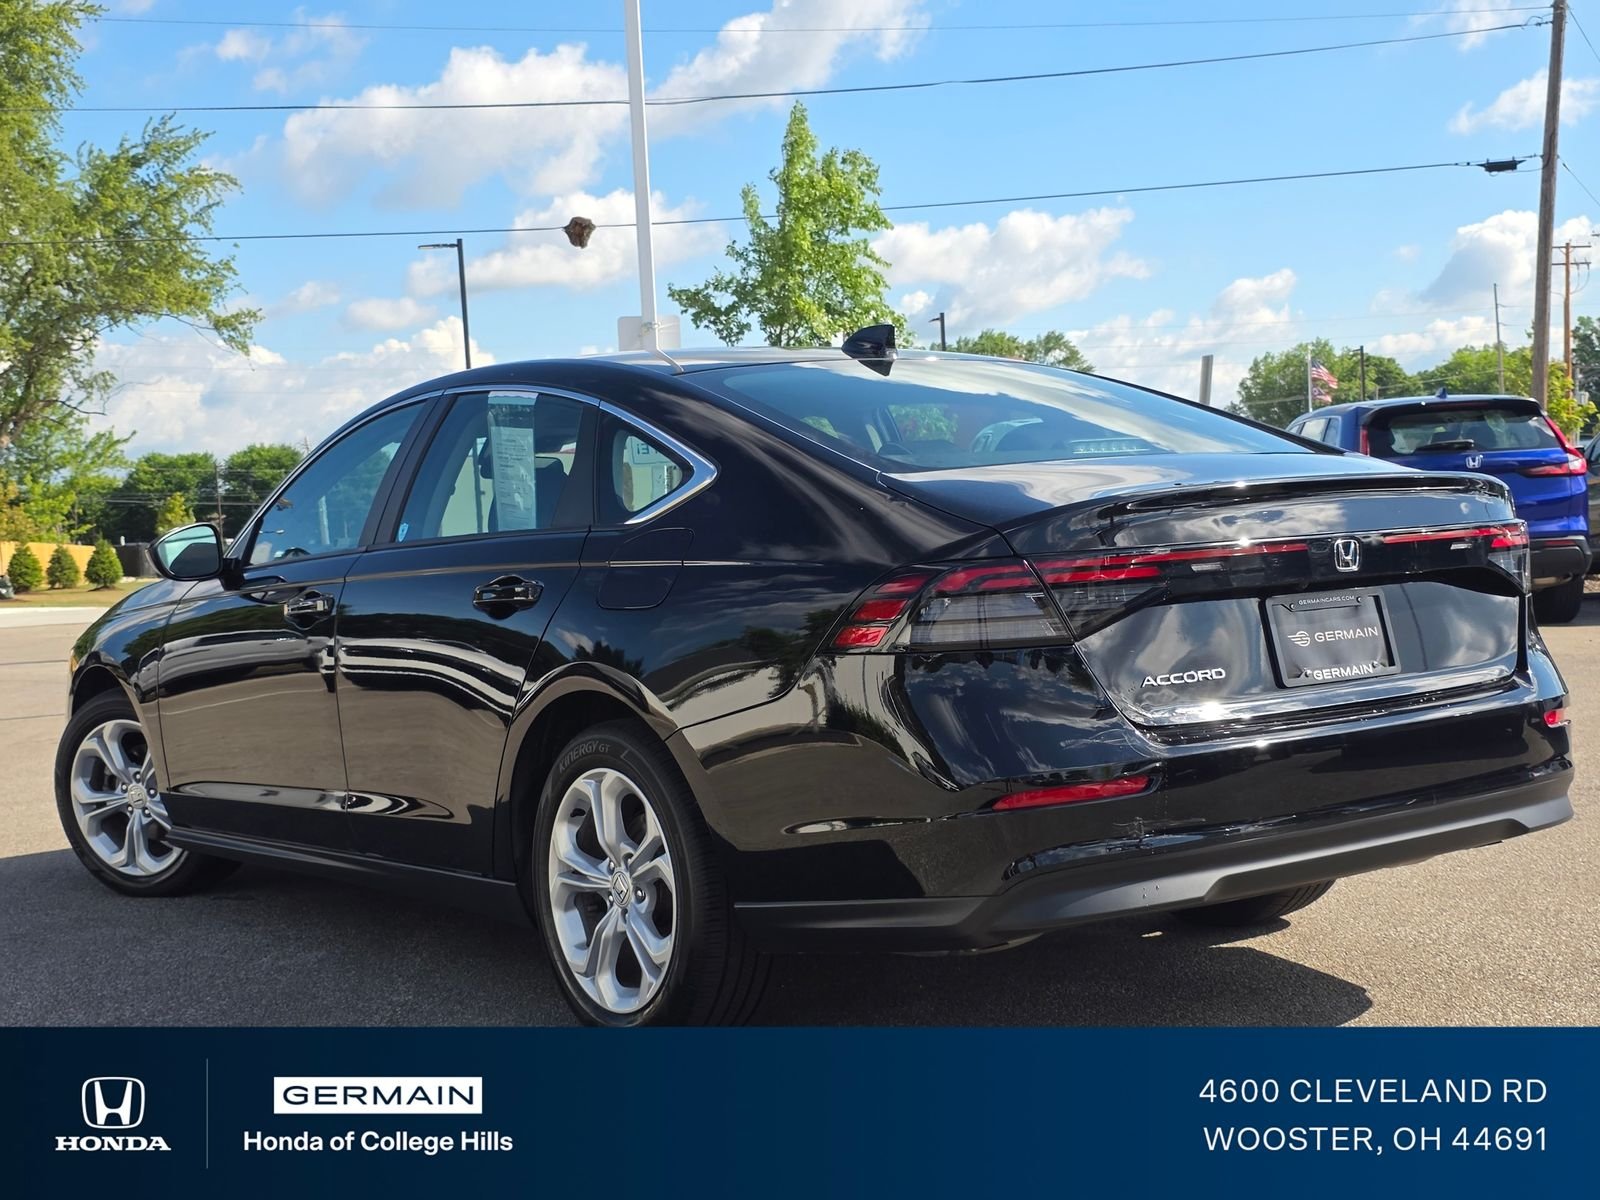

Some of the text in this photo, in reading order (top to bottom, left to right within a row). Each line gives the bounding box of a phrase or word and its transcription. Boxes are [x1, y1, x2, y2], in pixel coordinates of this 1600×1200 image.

[1298, 595, 1355, 606] GERMAINCARS.COM
[1314, 626, 1379, 643] GERMAIN
[1141, 667, 1226, 688] ACCORD
[1312, 663, 1375, 681] GERMAIN
[598, 743, 611, 753] GT
